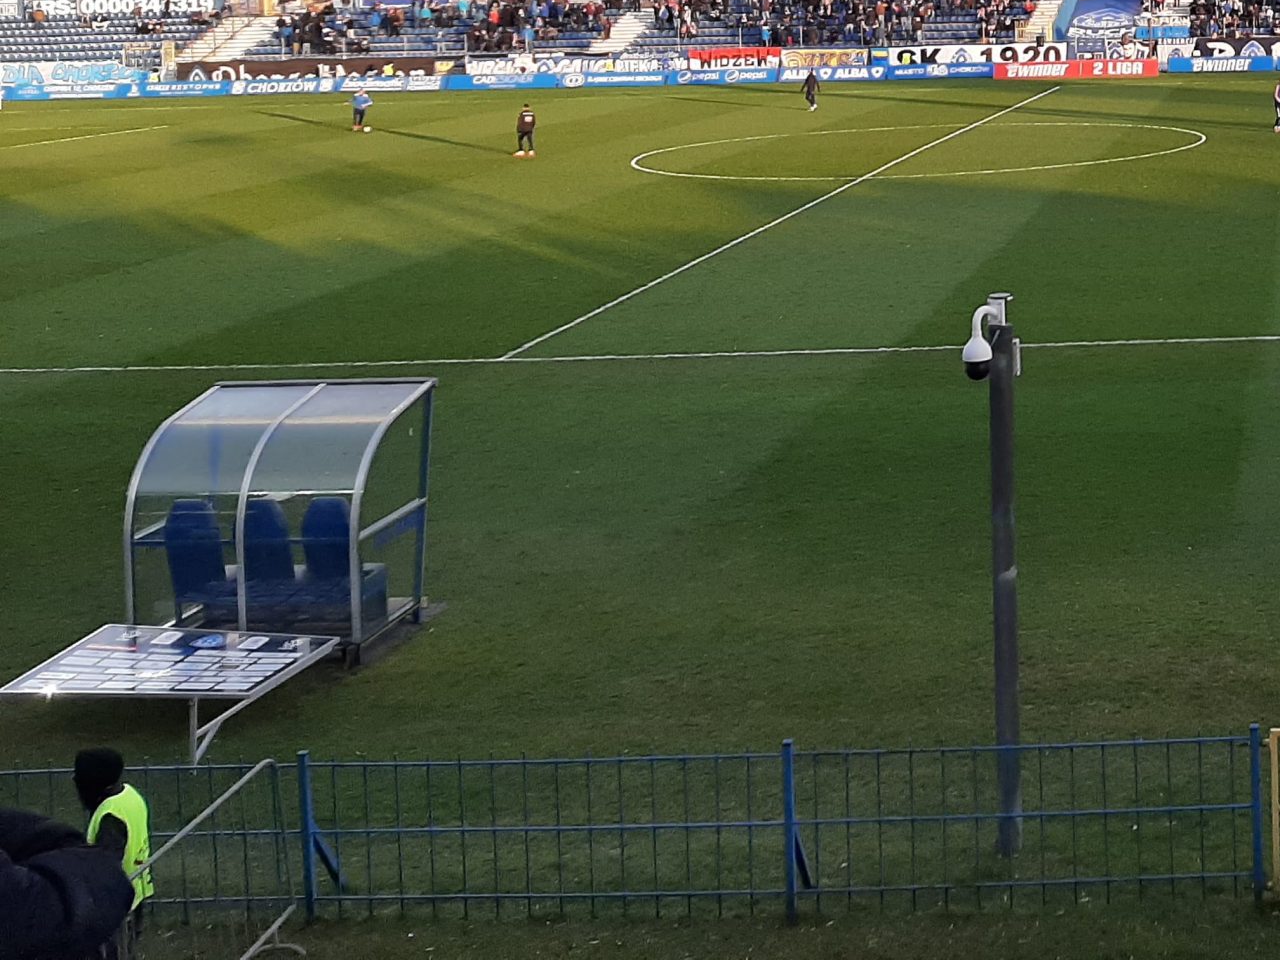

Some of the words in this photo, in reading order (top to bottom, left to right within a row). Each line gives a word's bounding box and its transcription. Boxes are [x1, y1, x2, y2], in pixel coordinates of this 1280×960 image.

[700, 51, 768, 69] WIDZEW
[980, 46, 1062, 64] 1920
[834, 68, 870, 79] ALBA
[1093, 62, 1104, 75] 2
[1107, 62, 1143, 75] LIGA
[692, 72, 719, 81] pepsi
[740, 71, 768, 81] pepsi
